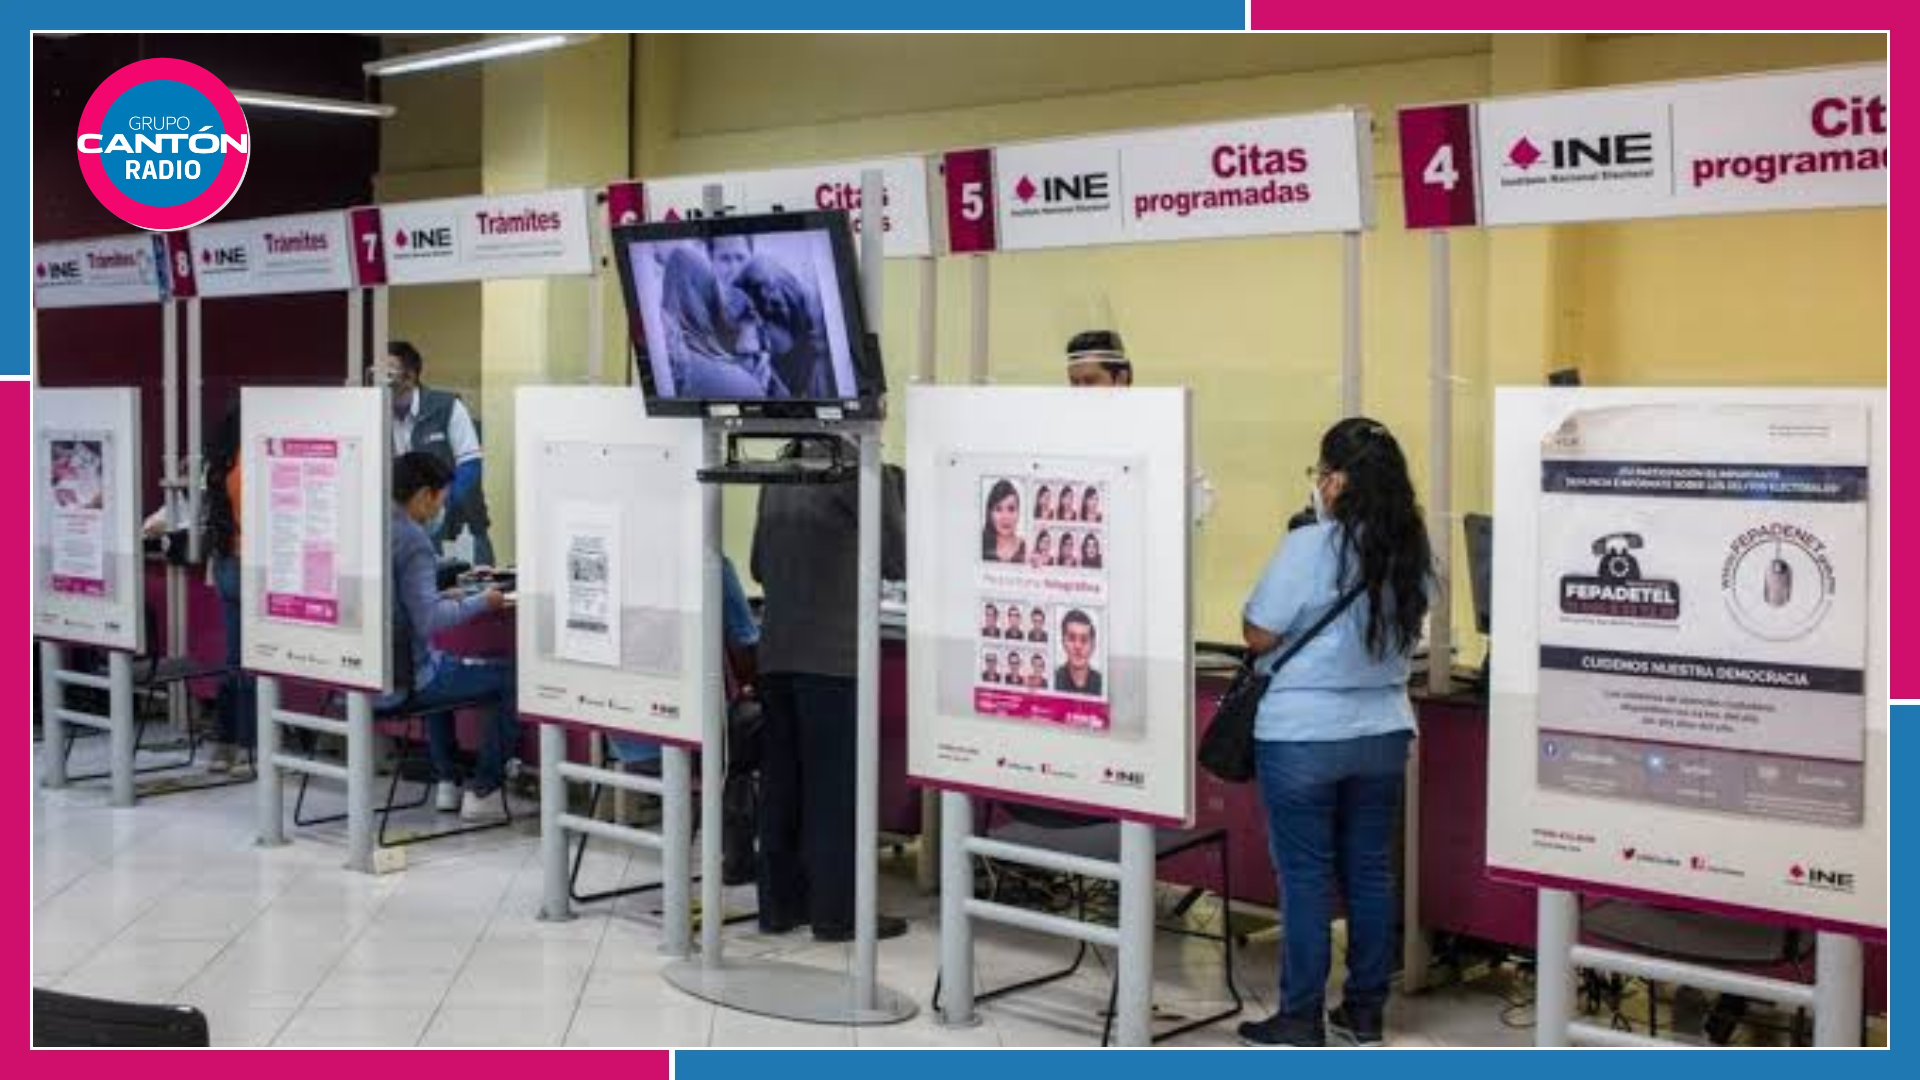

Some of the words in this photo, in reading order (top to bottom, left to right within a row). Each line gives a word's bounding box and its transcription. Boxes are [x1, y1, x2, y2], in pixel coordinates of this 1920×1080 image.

[1211, 144, 1308, 178] Citas
[1552, 132, 1653, 169] INE
[1692, 146, 1888, 187] programa
[1423, 145, 1459, 191] 4
[961, 182, 984, 221] 5
[1043, 171, 1109, 203] INE
[1135, 179, 1311, 219] programadas
[362, 233, 377, 263] 7
[411, 228, 452, 249] INE
[49, 261, 82, 280] INE
[176, 251, 189, 277] 8
[215, 247, 247, 266] INE
[1565, 583, 1677, 604] FEPADETEL
[1582, 655, 1649, 674] CUIDEMOS
[1651, 661, 1714, 680] NUESTRA
[1716, 666, 1810, 687] DEMOCRACIA
[1808, 867, 1855, 886] INE
